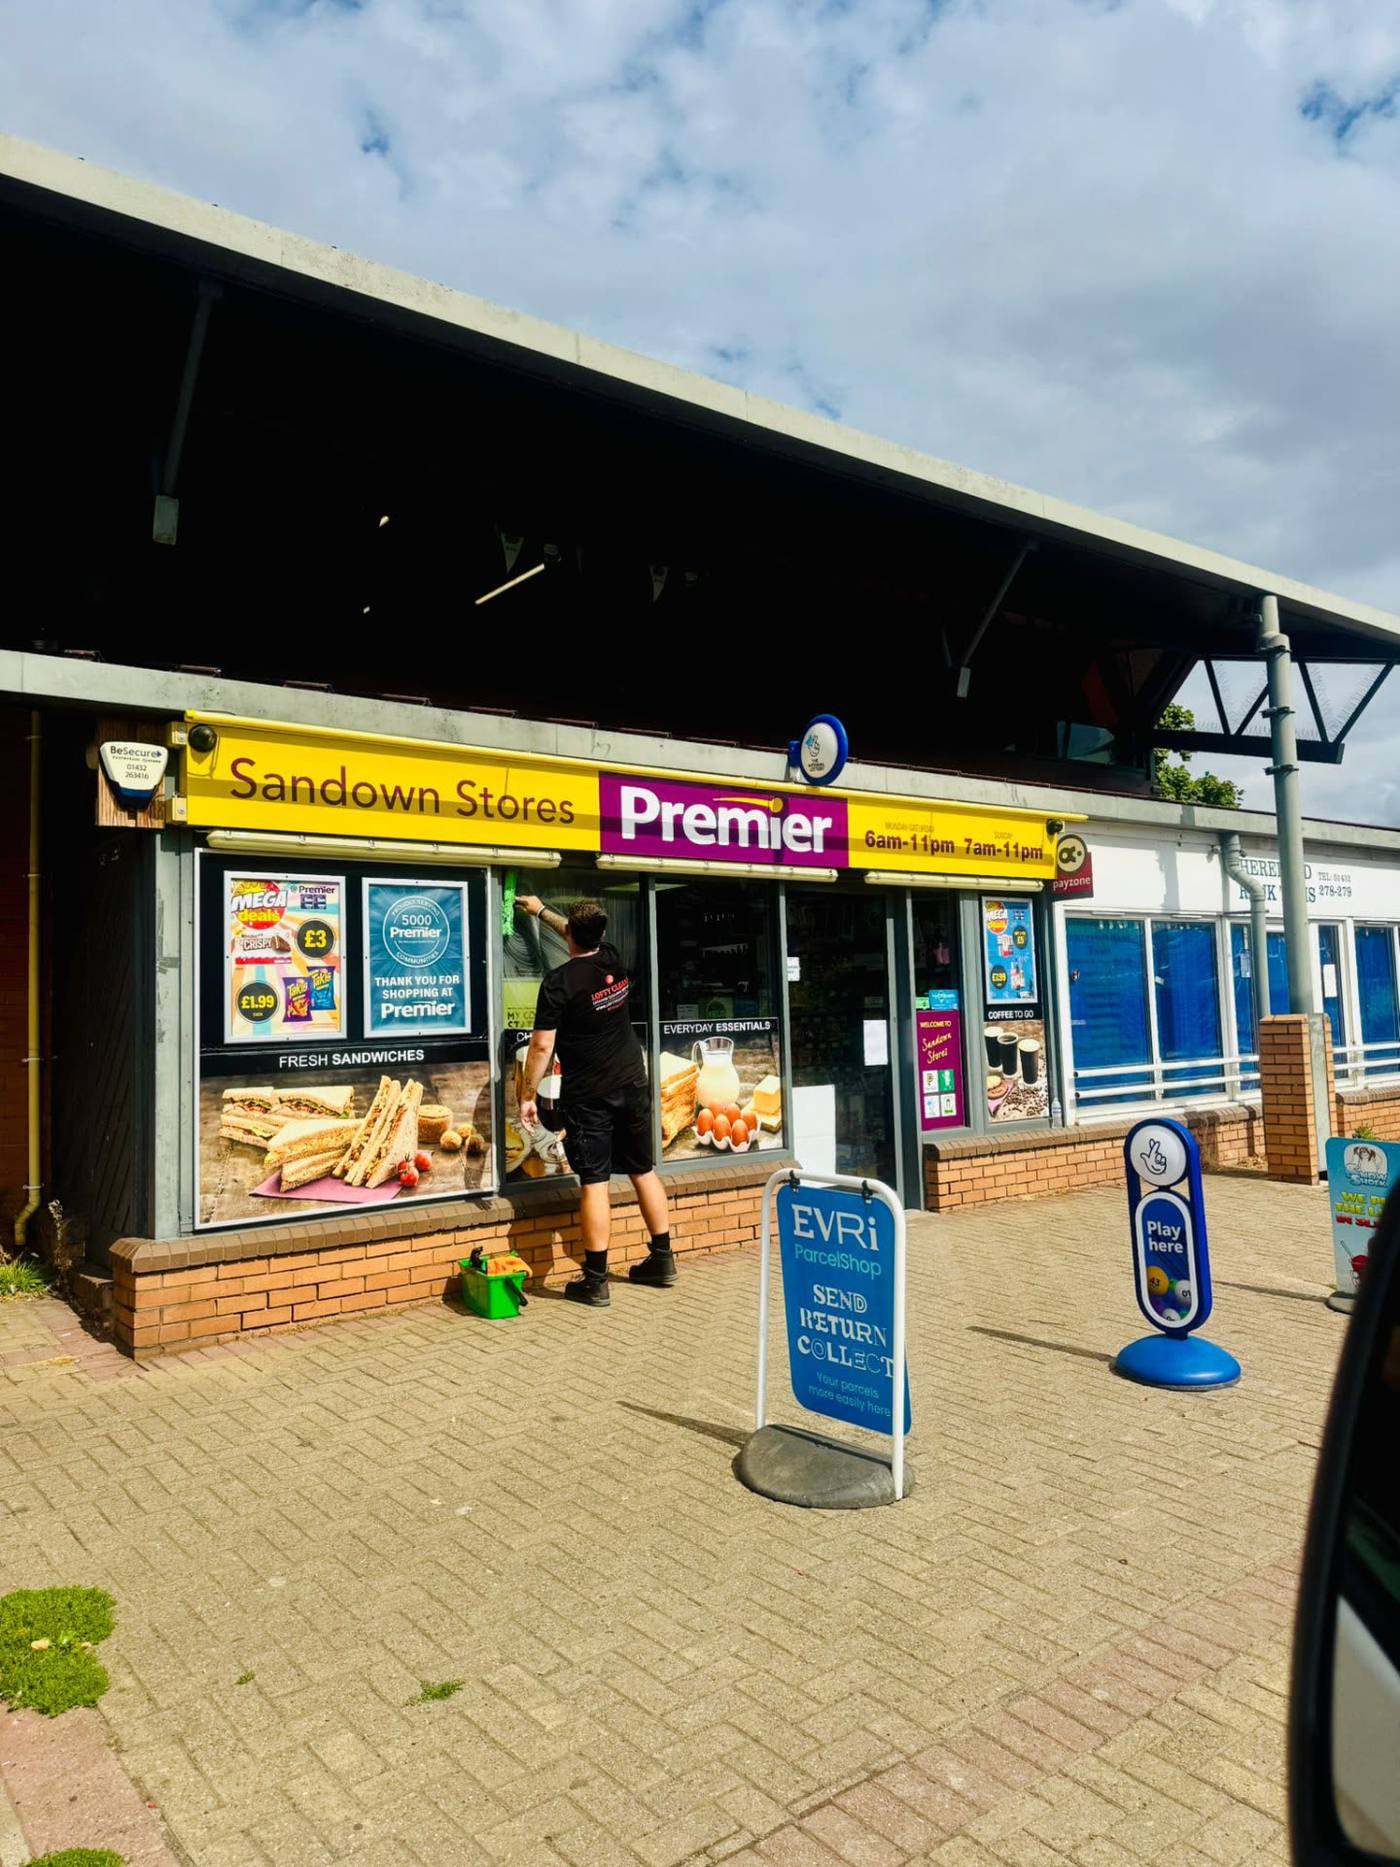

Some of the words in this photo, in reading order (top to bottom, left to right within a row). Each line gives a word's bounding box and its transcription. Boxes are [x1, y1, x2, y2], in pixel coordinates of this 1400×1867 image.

[110, 745, 157, 758] BeSecure
[126, 763, 147, 771] 01432
[230, 757, 440, 814] Sandown
[456, 779, 575, 825] Stores
[620, 785, 833, 853] Premier
[865, 829, 954, 856] 6am-11pm
[964, 838, 1043, 862] 7am-11pm
[298, 885, 336, 894] Premier
[1053, 877, 1091, 891] payzone
[231, 890, 288, 913] MEGA
[237, 908, 280, 922] deals
[402, 914, 432, 926] 5000
[304, 929, 327, 948] £3
[390, 926, 442, 938] Premier
[374, 976, 413, 987] THANK
[415, 975, 437, 986] YOU
[439, 974, 460, 984] FOR
[241, 995, 275, 1009] £1.99
[382, 988, 439, 999] SHOPPING
[441, 987, 454, 997] AT
[381, 1001, 455, 1019] Premier
[988, 1010, 1014, 1019] COFFEE
[1015, 1010, 1023, 1018] TO
[1024, 1010, 1034, 1018] GO
[663, 1023, 713, 1034] EVERYDAY
[716, 1021, 771, 1032] ESSENTIALS
[279, 1054, 328, 1068] FRESH
[331, 1049, 425, 1065] SANDWICHES
[927, 1047, 948, 1064] Stores
[791, 1203, 880, 1251] EVRi
[1147, 1220, 1181, 1241] Play
[1148, 1236, 1184, 1254] here
[794, 1243, 882, 1280] ParcelShop
[812, 1283, 867, 1313] SEND
[800, 1307, 887, 1348] RETURN
[797, 1335, 895, 1378] COLLECT
[816, 1371, 839, 1386] Your
[841, 1380, 880, 1399] parcels
[836, 1393, 865, 1411] easily
[868, 1400, 892, 1417] here
